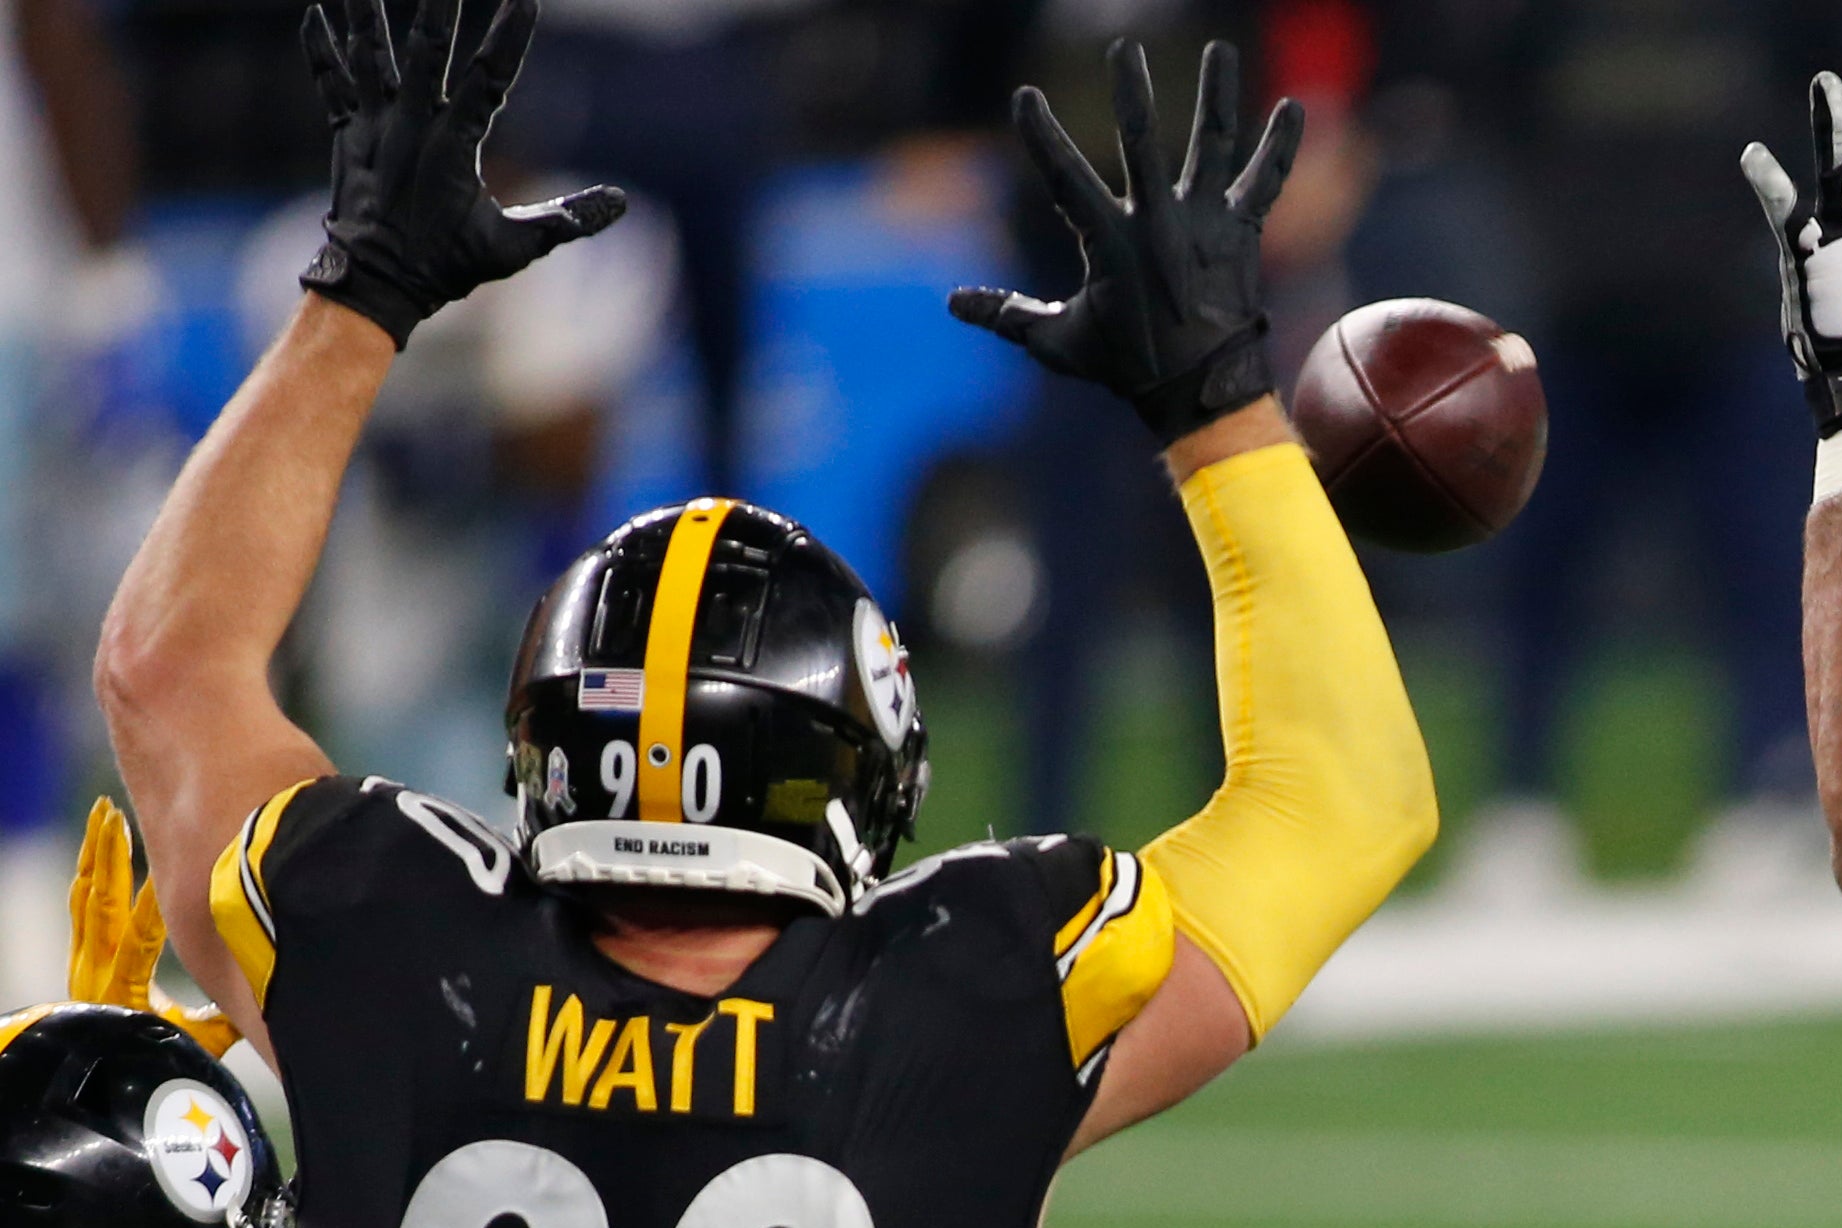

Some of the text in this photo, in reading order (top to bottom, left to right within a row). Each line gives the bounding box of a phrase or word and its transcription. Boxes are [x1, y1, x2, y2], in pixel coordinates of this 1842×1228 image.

[600, 739, 722, 824] 90
[614, 836, 709, 856] END RACISM
[524, 985, 775, 1116] WATT
